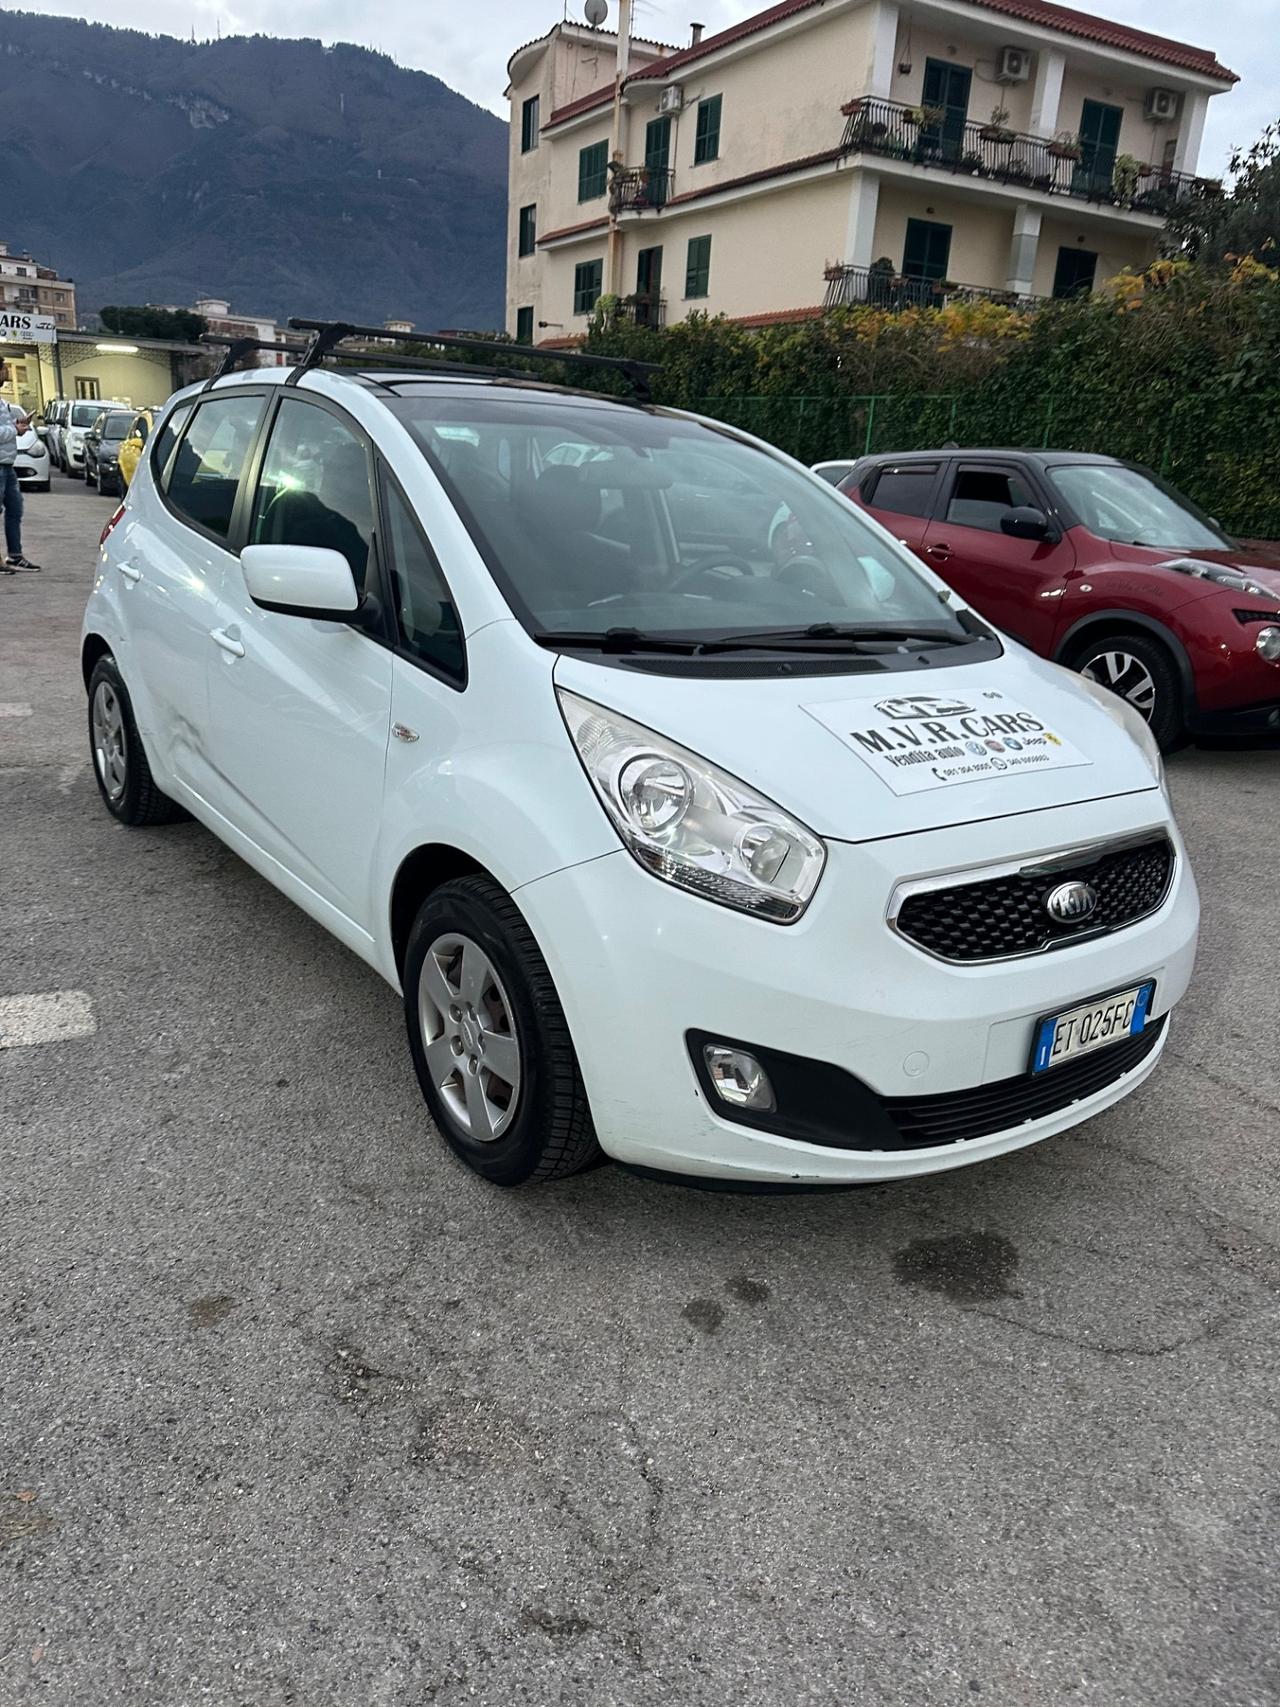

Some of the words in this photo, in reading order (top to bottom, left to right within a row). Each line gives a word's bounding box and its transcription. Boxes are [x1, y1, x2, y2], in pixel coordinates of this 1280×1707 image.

[884, 749, 937, 767] Vendita
[935, 745, 966, 760] auto
[1059, 889, 1093, 916] KIA
[1052, 1018, 1078, 1057] ET
